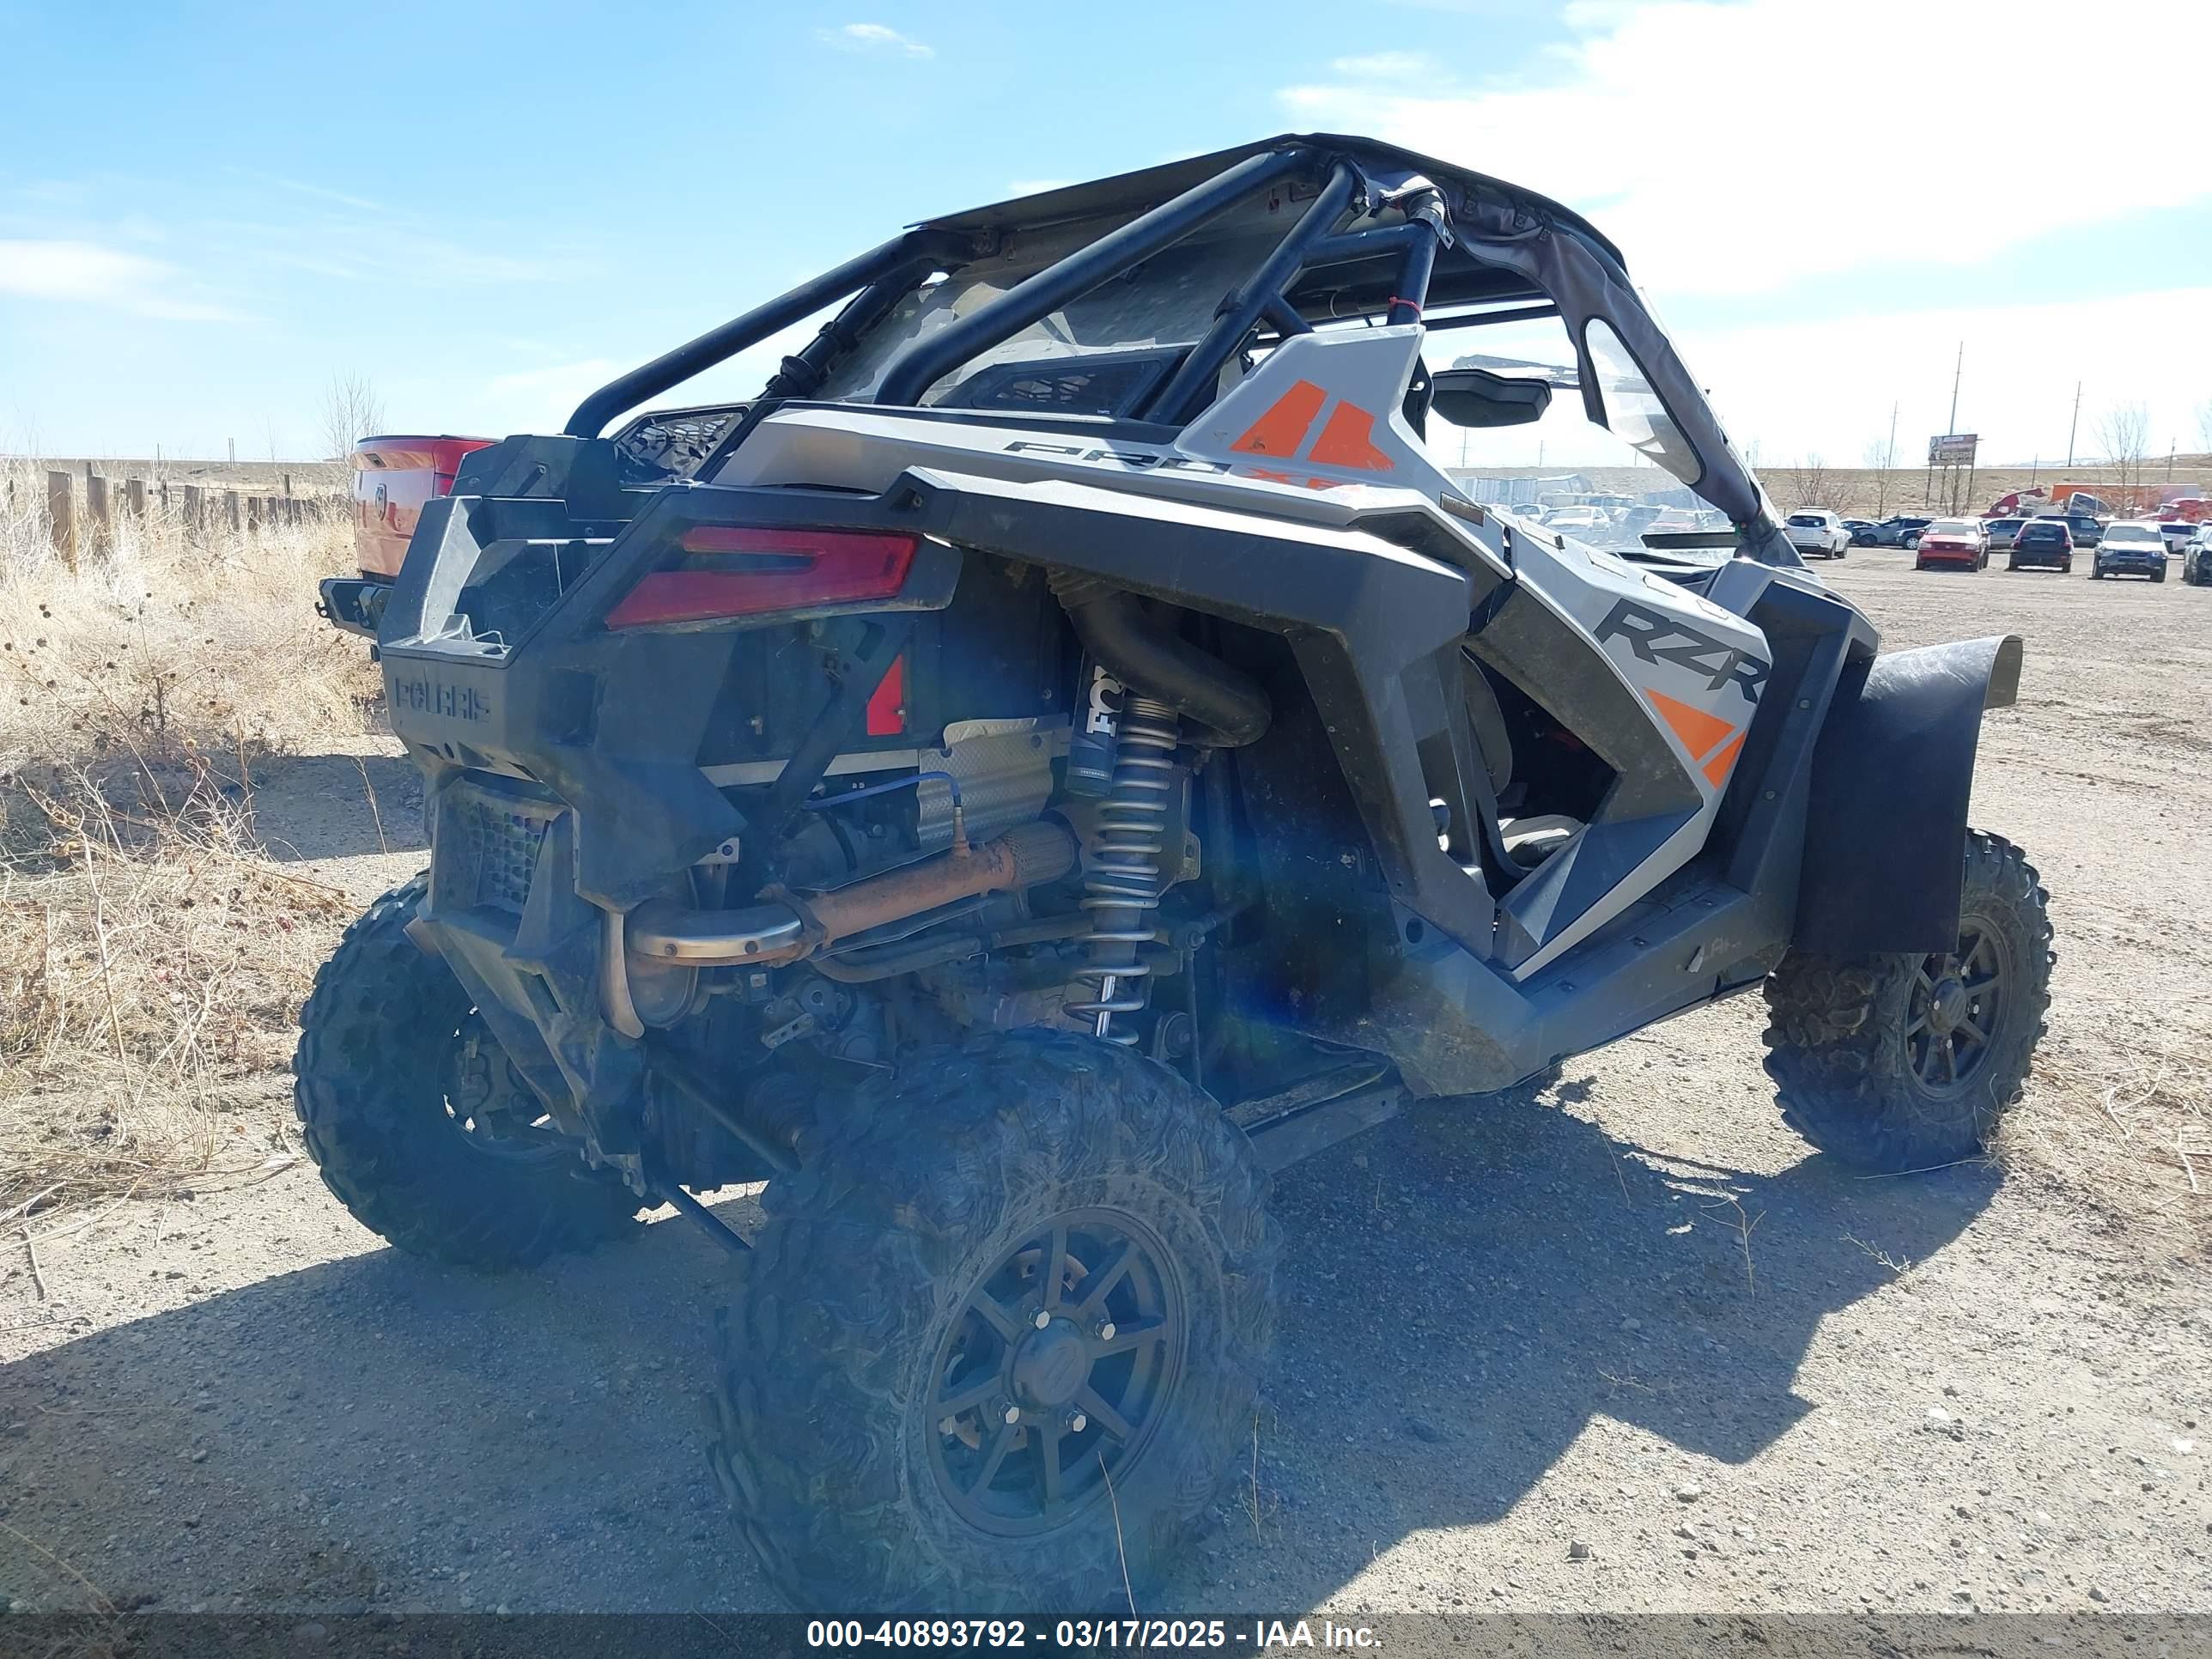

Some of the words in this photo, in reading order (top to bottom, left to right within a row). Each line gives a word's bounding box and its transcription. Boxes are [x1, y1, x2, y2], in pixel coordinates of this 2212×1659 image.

[1003, 441, 1232, 475] PRO
[1593, 598, 1771, 705] RZR
[394, 676, 490, 723] POLARIS
[1085, 665, 1125, 738] FO
